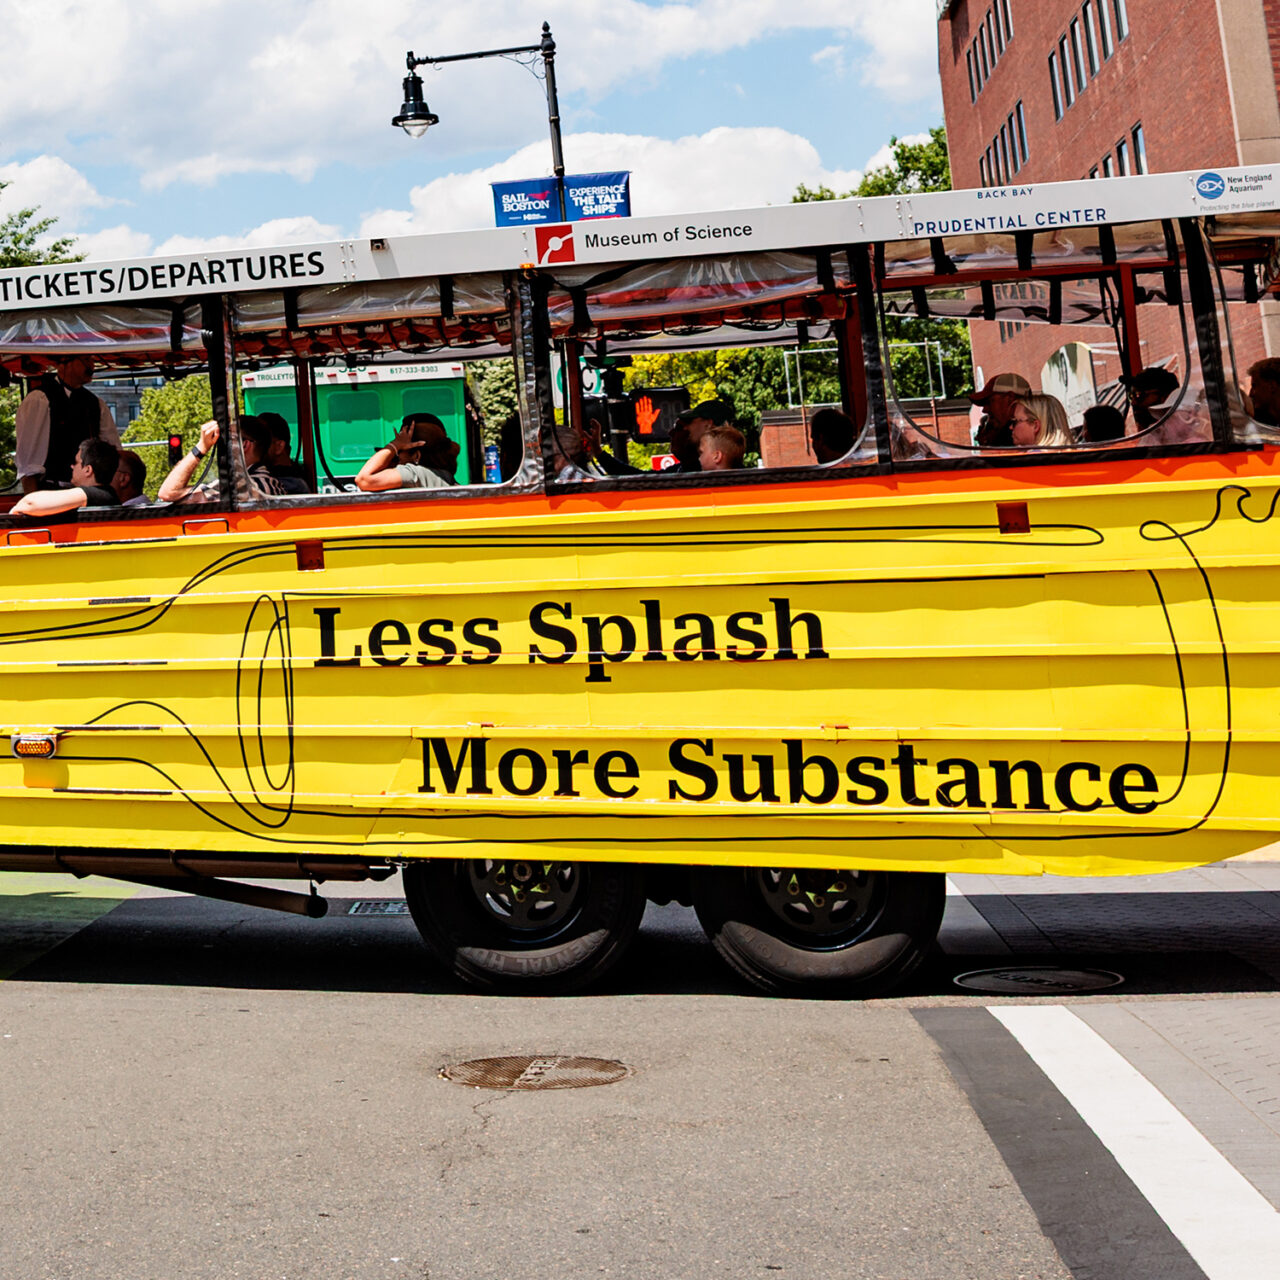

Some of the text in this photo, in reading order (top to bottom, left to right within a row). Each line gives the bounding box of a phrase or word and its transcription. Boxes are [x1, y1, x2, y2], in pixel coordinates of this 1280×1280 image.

[1227, 173, 1272, 184] New England
[568, 184, 626, 198] EXPERIENCE
[977, 187, 1034, 200] BACK BAY
[1229, 183, 1263, 194] Aquarium
[501, 192, 529, 204] SAIL
[572, 193, 625, 207] THE TALL
[503, 200, 550, 213] BOSTON
[582, 203, 617, 216] SHIPS
[914, 208, 1107, 236] PRUDENTIAL CENTER
[584, 224, 753, 249] Museum of Science
[313, 598, 830, 683] Less Splash
[418, 737, 1159, 814] More Substance
